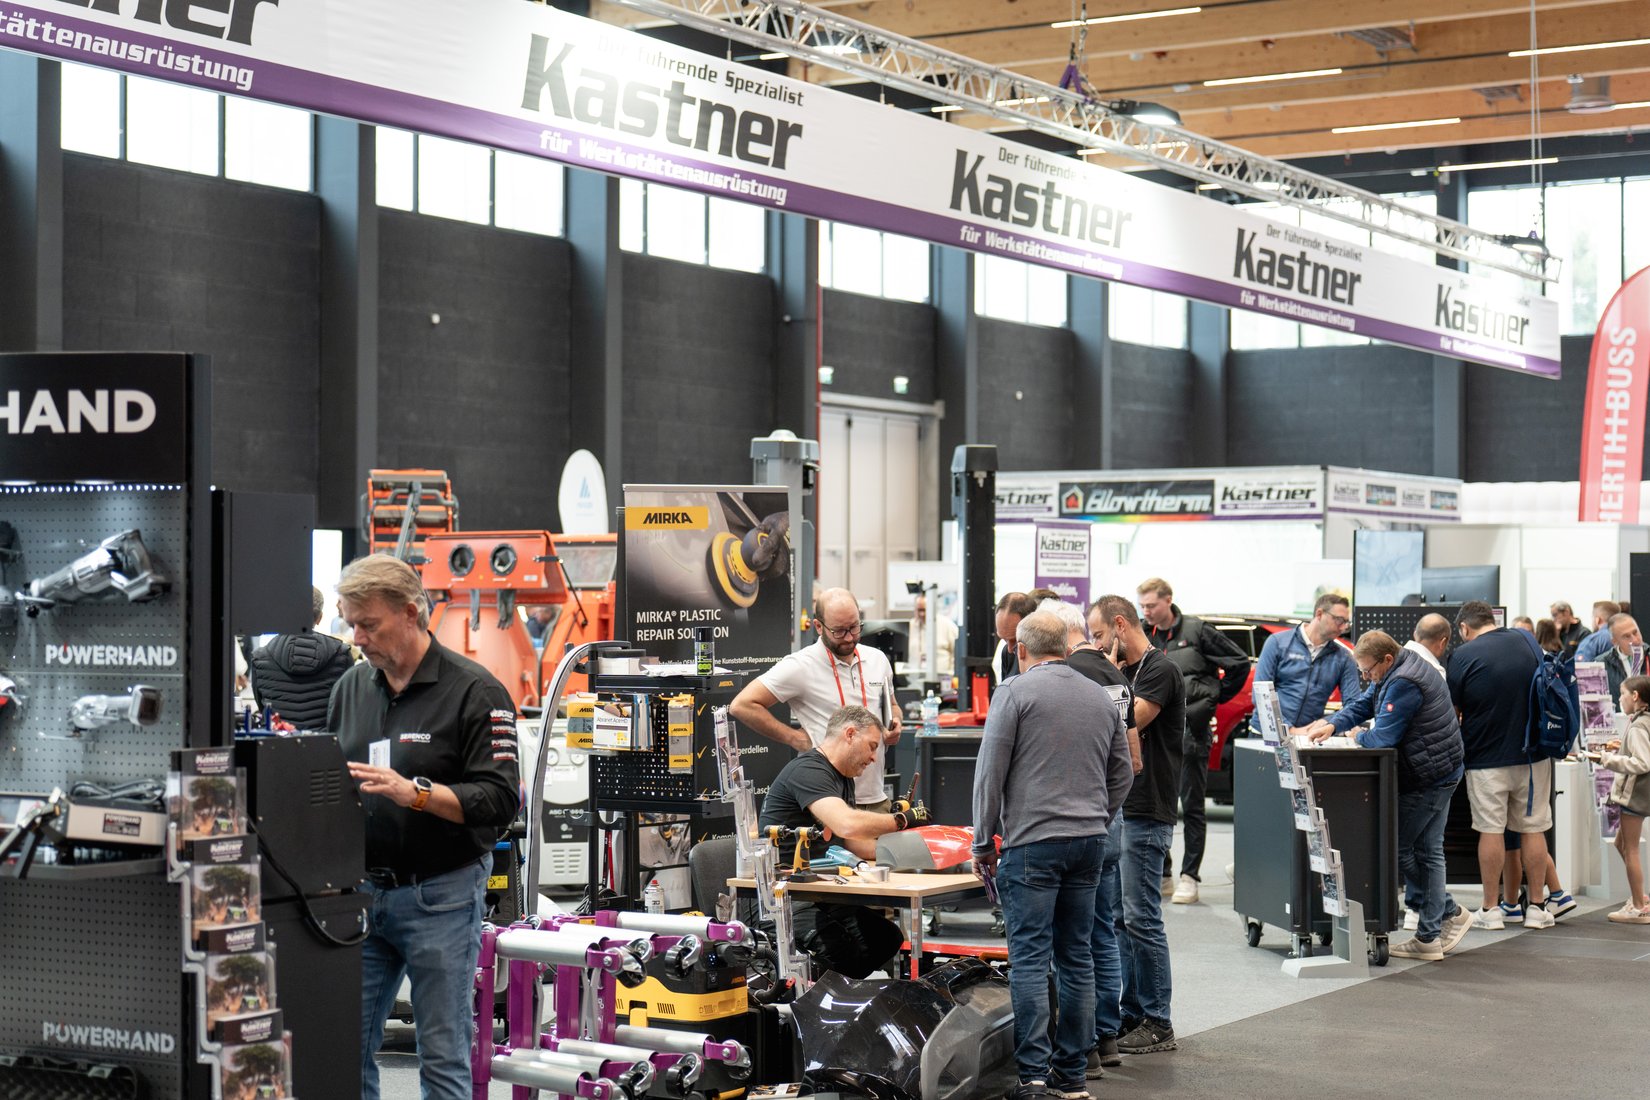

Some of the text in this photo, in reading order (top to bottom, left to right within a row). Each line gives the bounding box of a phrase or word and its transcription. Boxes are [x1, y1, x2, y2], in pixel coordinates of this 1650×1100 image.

[521, 33, 804, 170] Kastner
[725, 70, 805, 107] Spezialist
[540, 131, 788, 206] für Werkstättenausrüstung
[998, 147, 1020, 166] Der
[950, 148, 1132, 249] Kastner
[960, 225, 982, 243] für
[1266, 224, 1363, 263] Der führende Spezialist
[1233, 227, 1362, 306] Kastner
[1435, 283, 1530, 346] Kastner
[0, 389, 157, 434] HAND
[1085, 488, 1212, 513] Blowtherm
[1222, 486, 1317, 501] Kastner
[643, 512, 694, 525] MIRKA
[1040, 535, 1087, 552] Kastner
[679, 608, 722, 622] PLASTIC
[636, 626, 729, 642] REPAIR SOLON
[45, 642, 178, 667] POWERHAND
[43, 1020, 176, 1055] POWERHAND
